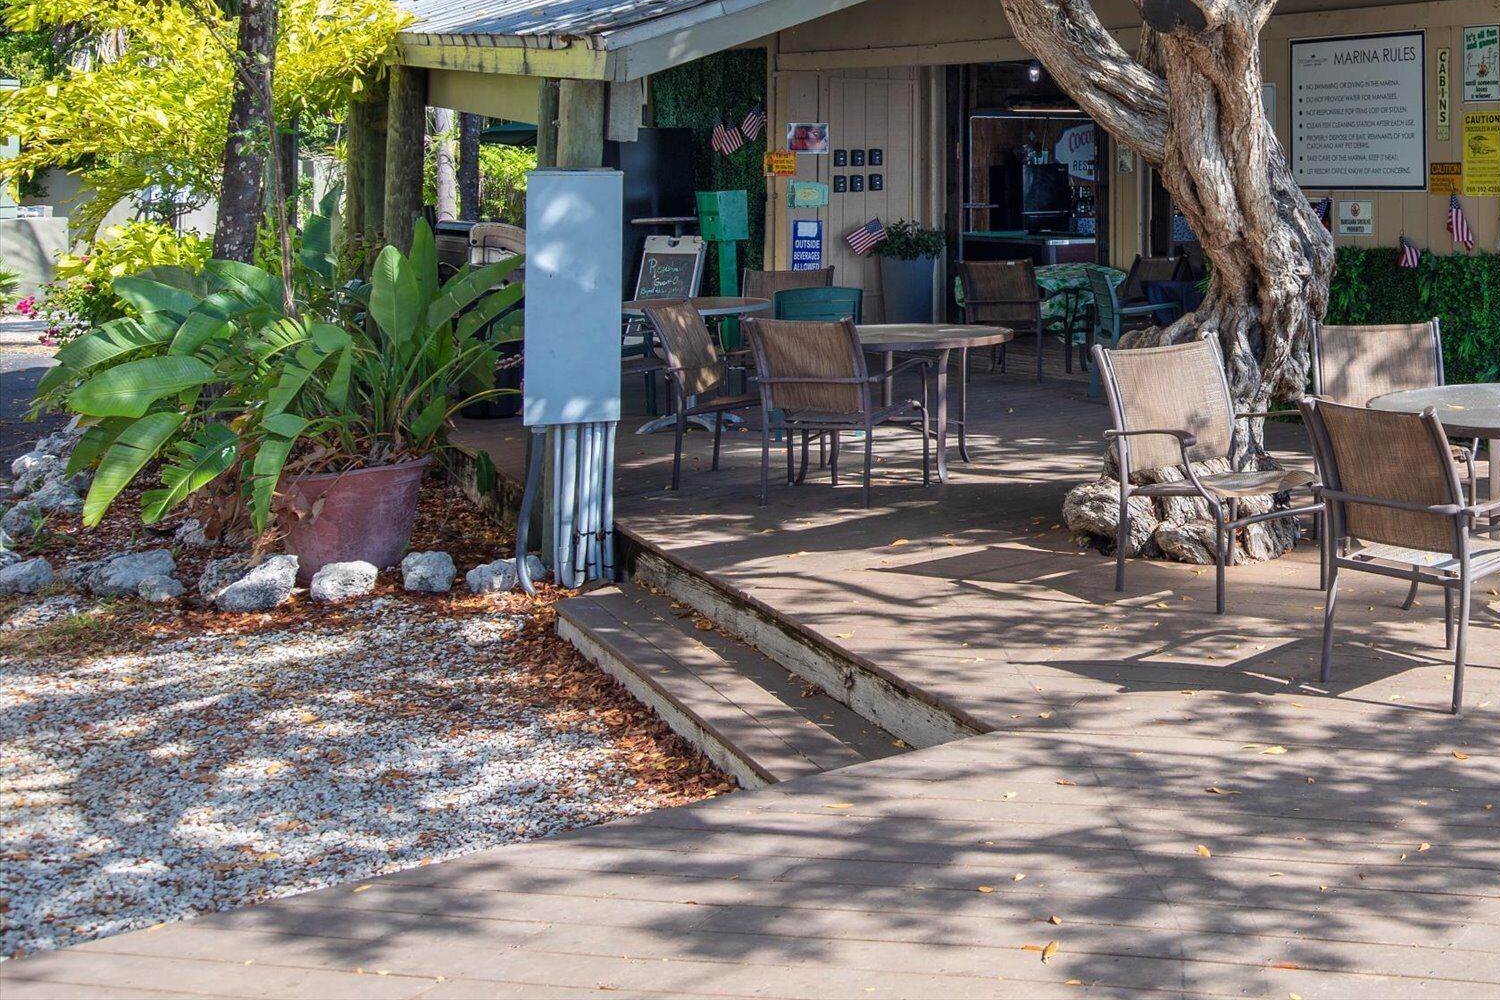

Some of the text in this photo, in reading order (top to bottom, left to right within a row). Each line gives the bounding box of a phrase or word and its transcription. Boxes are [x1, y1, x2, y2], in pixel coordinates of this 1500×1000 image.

[1487, 29, 1497, 38] fun
[1333, 46, 1416, 64] MARINA RULES
[1439, 52, 1447, 122] CABINS
[1466, 114, 1500, 123] CAUTION
[1069, 131, 1094, 153] Coco
[1432, 164, 1460, 174] CAUTION
[795, 240, 820, 248] OUTSIDE
[794, 252, 820, 260] BEVERAGES
[793, 263, 820, 271] ALLOWED
